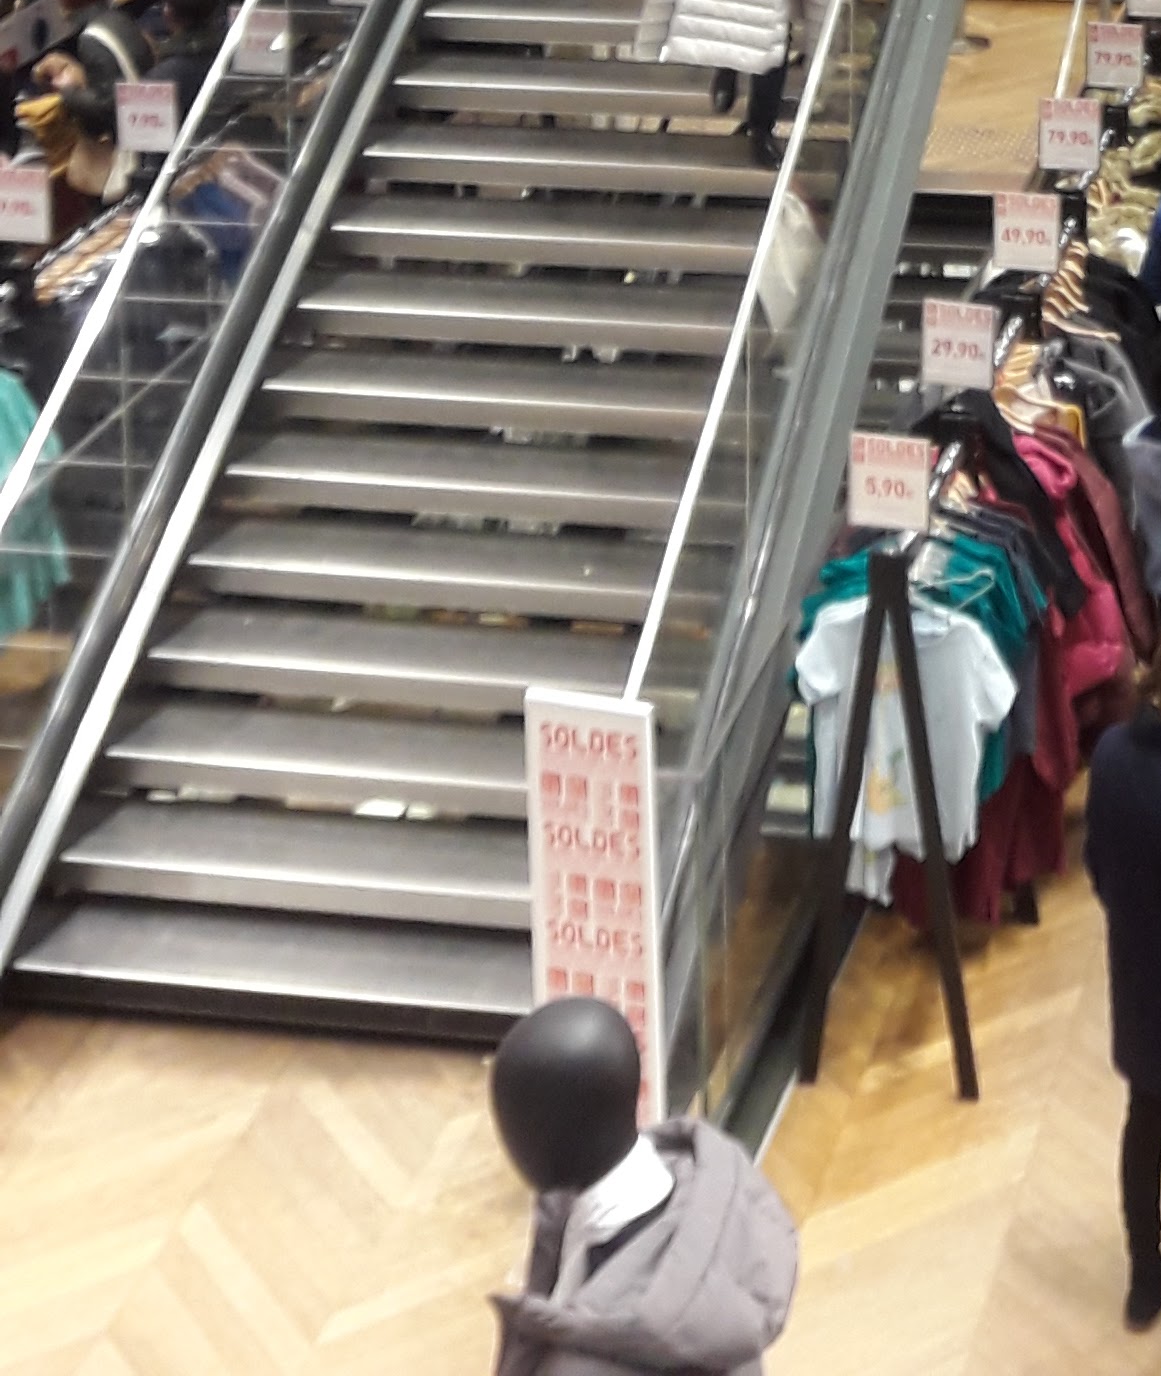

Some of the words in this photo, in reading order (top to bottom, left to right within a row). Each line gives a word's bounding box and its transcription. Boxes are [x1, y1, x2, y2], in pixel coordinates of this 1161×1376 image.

[540, 722, 638, 761] SOLDES
[543, 821, 641, 862] SOLDES
[546, 919, 643, 960] SOLDES
